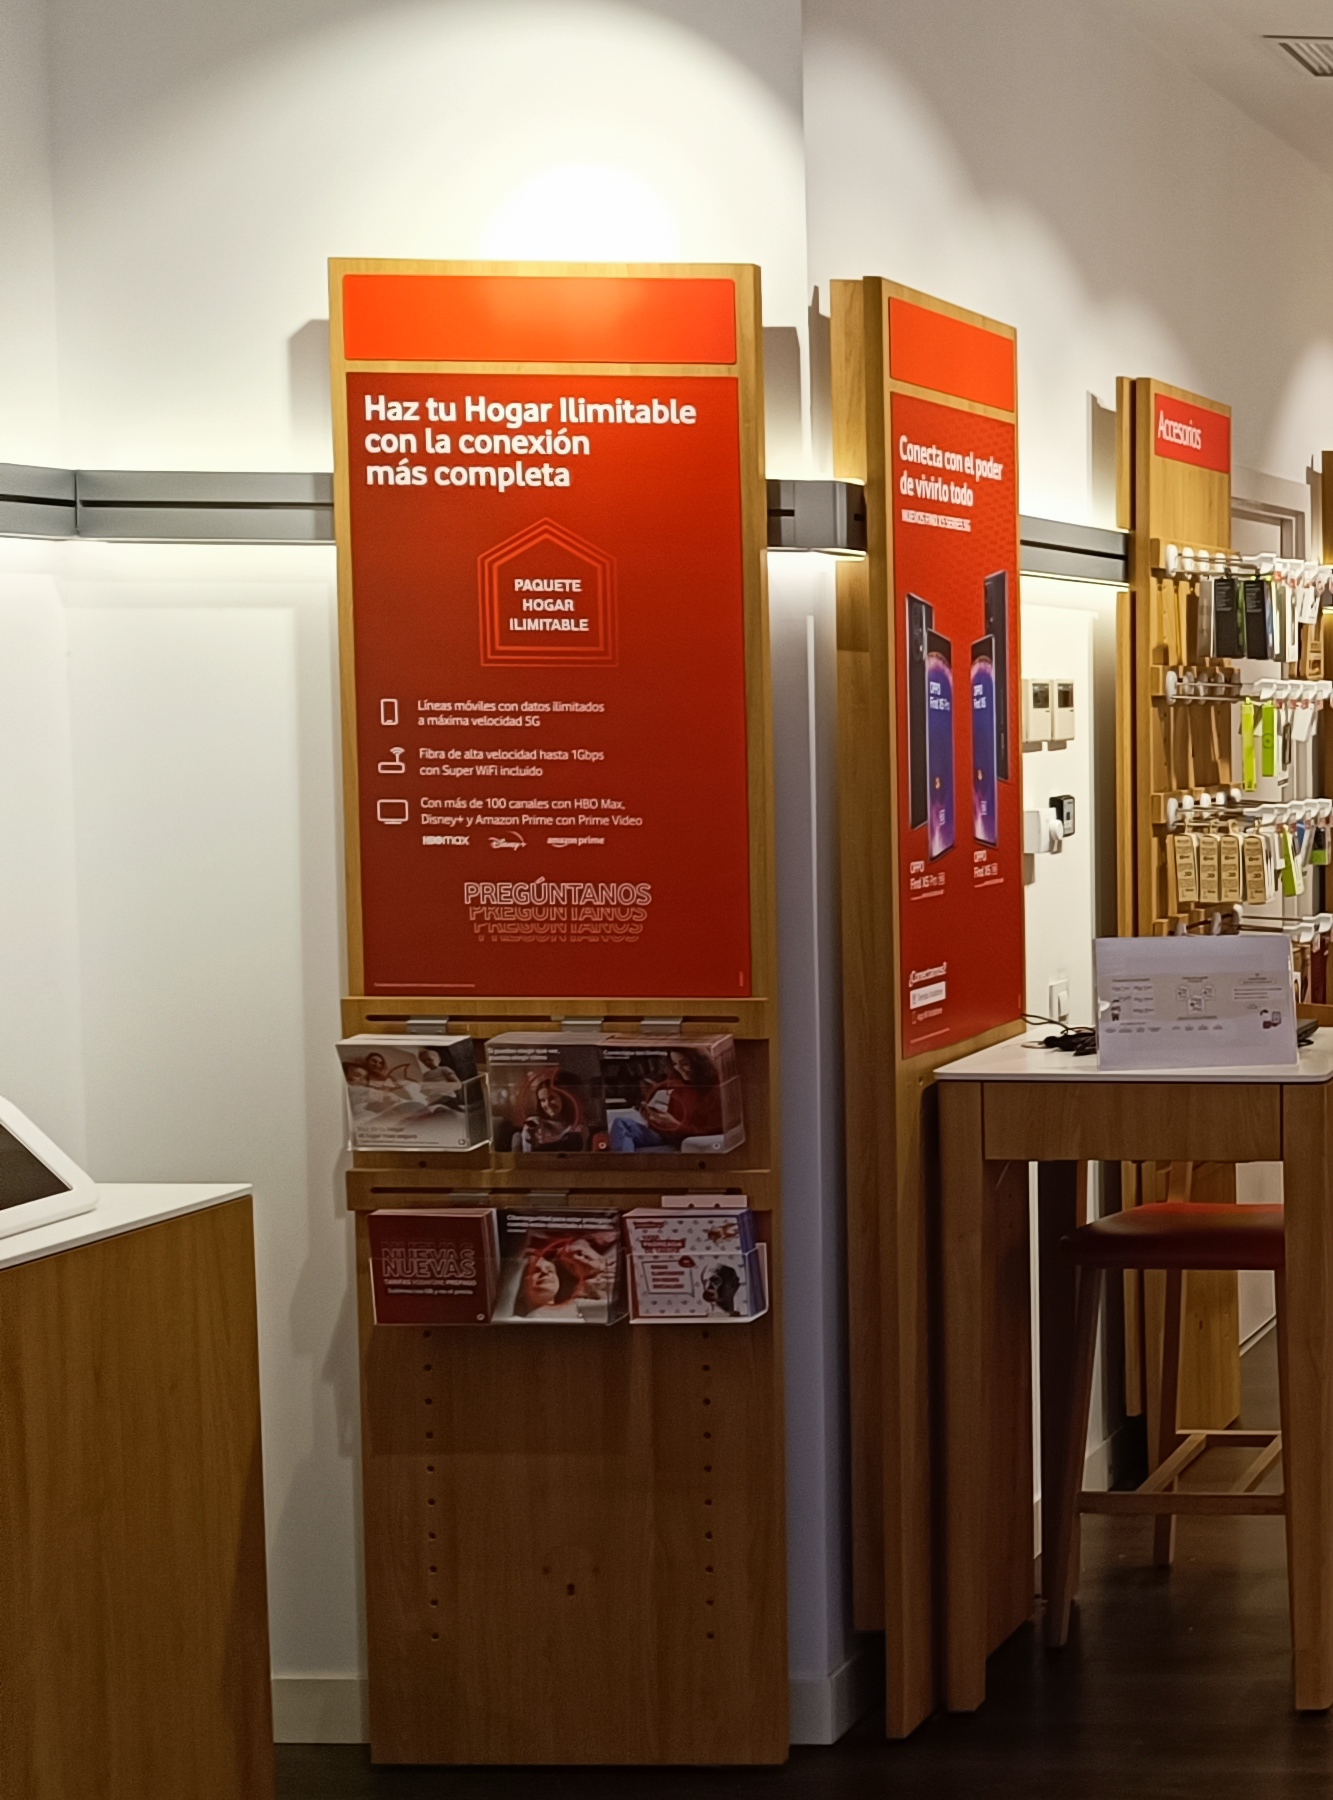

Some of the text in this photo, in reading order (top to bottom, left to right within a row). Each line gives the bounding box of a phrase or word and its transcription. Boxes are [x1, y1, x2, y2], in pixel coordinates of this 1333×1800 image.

[364, 395, 697, 429] Haz tu Hogar Ilimitable
[1158, 409, 1202, 450] Accesorios
[364, 427, 591, 455] con la conexión
[899, 435, 1003, 482] Conecta con el poder
[366, 459, 571, 492] más completa
[900, 470, 973, 507] de vivirlo todo
[514, 579, 582, 593] PAQUETE
[522, 598, 575, 612] HOGAR
[509, 618, 589, 633] ILIMITABLE
[417, 700, 605, 712] Líneas móviles con datos ilimitados
[417, 714, 541, 727] a máxima velocidad 5G
[419, 748, 605, 762] Fibra de alta velocidad hasta 1Gbps
[419, 765, 543, 778] con Super WiFi incluido
[420, 798, 442, 809] Con
[444, 797, 467, 809] más
[469, 798, 483, 809] de
[487, 798, 506, 809] 100
[508, 799, 549, 809] canales
[551, 800, 572, 809] con
[574, 799, 598, 810] HBO
[421, 814, 643, 827] Disney+ y Amazon Prime con Prime Video
[464, 876, 652, 905] PREGÚNTANOS
[382, 1259, 476, 1278] NUEVAS
